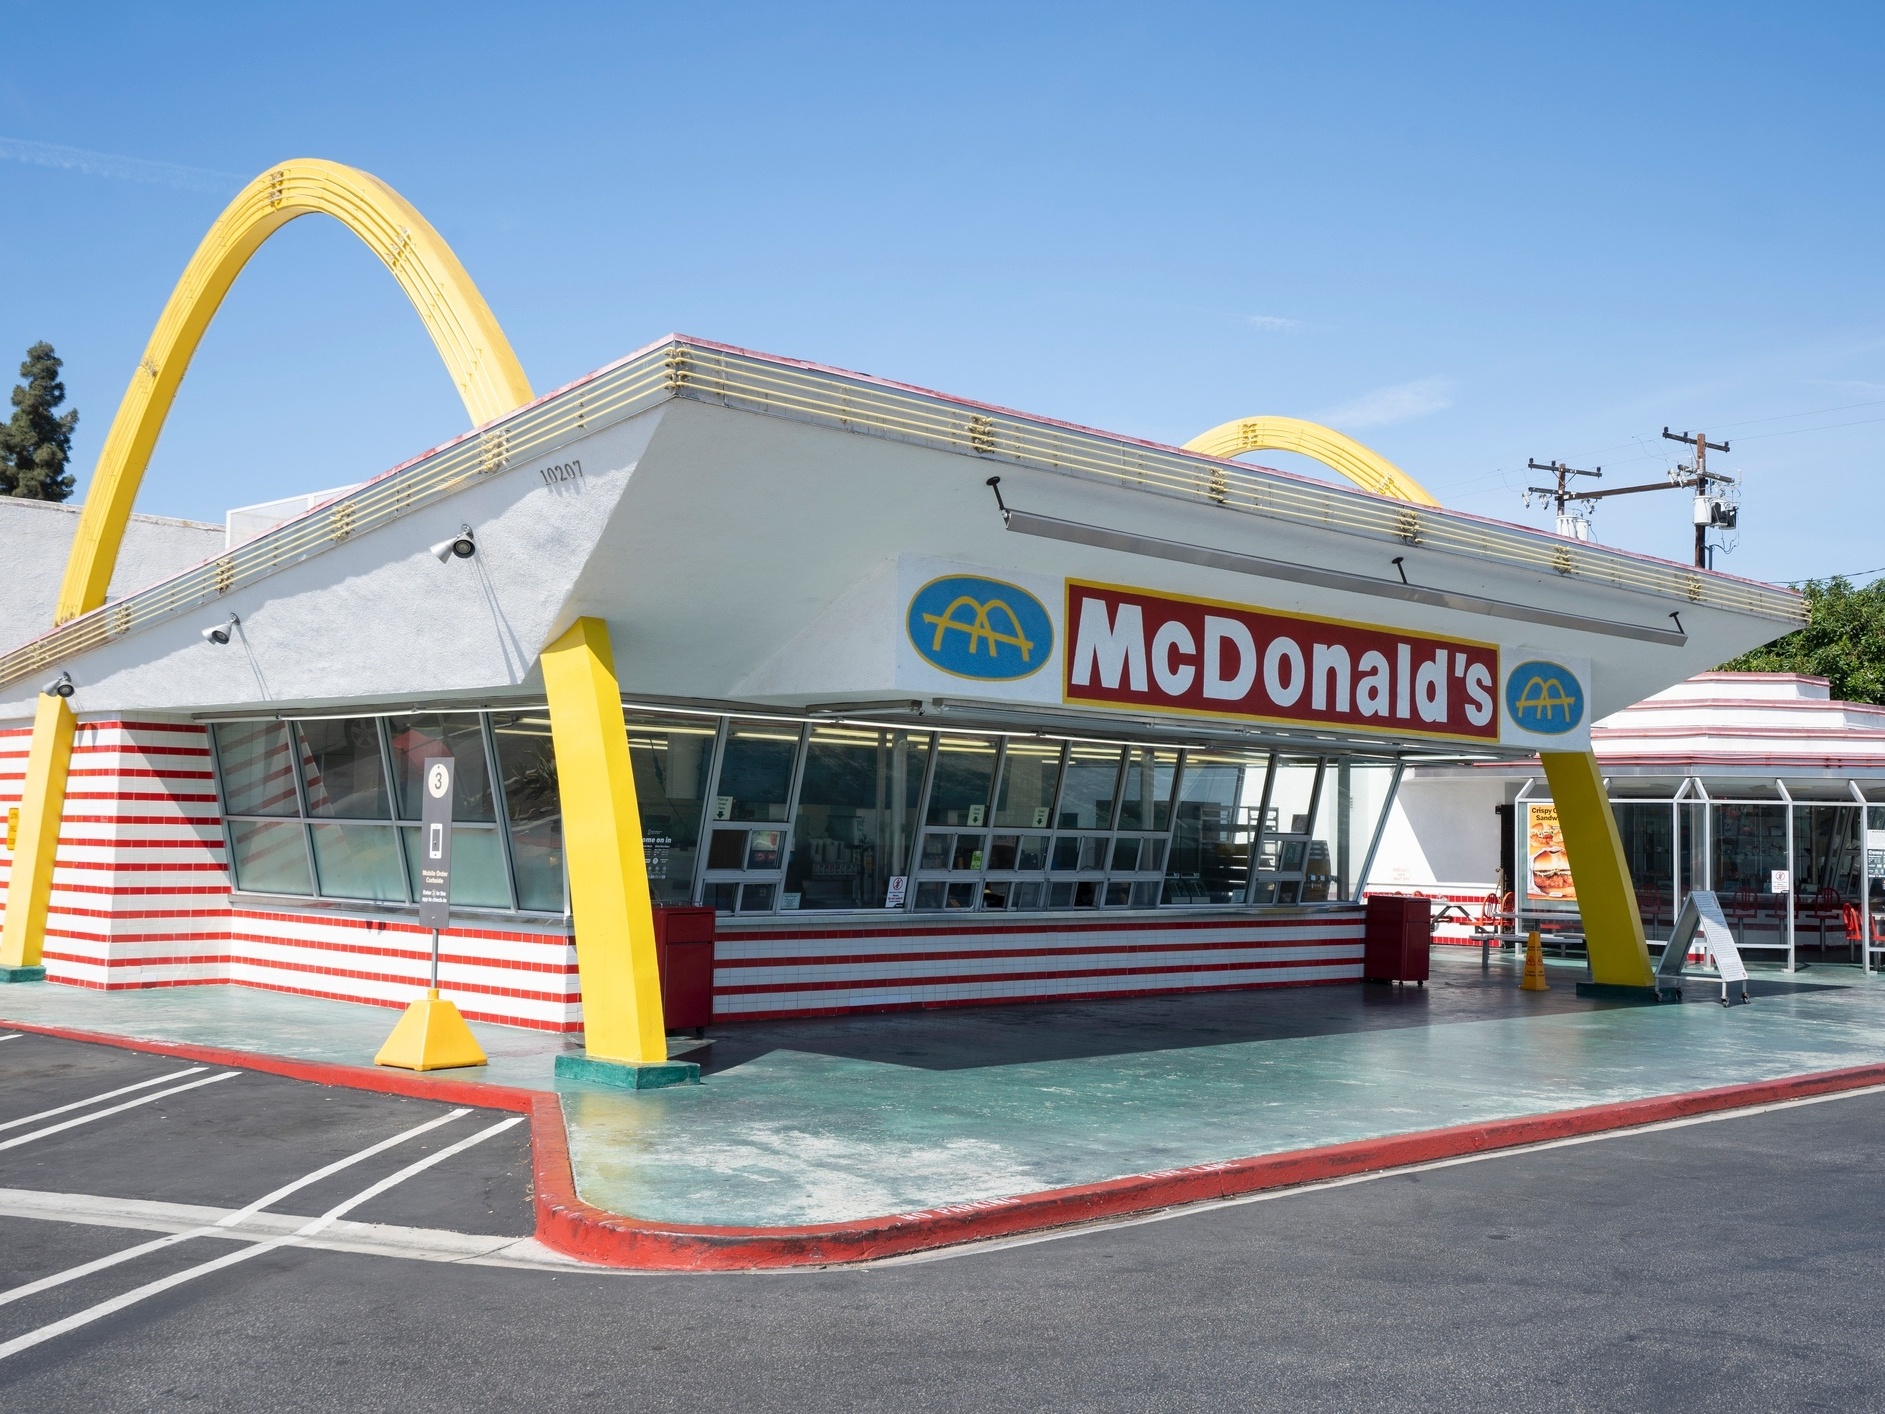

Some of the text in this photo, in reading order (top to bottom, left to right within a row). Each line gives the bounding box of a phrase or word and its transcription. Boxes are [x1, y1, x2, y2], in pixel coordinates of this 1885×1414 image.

[540, 460, 583, 485] 10207
[1071, 597, 1493, 727] McDonald's
[434, 772, 442, 790] 3
[425, 876, 444, 884] Curbside
